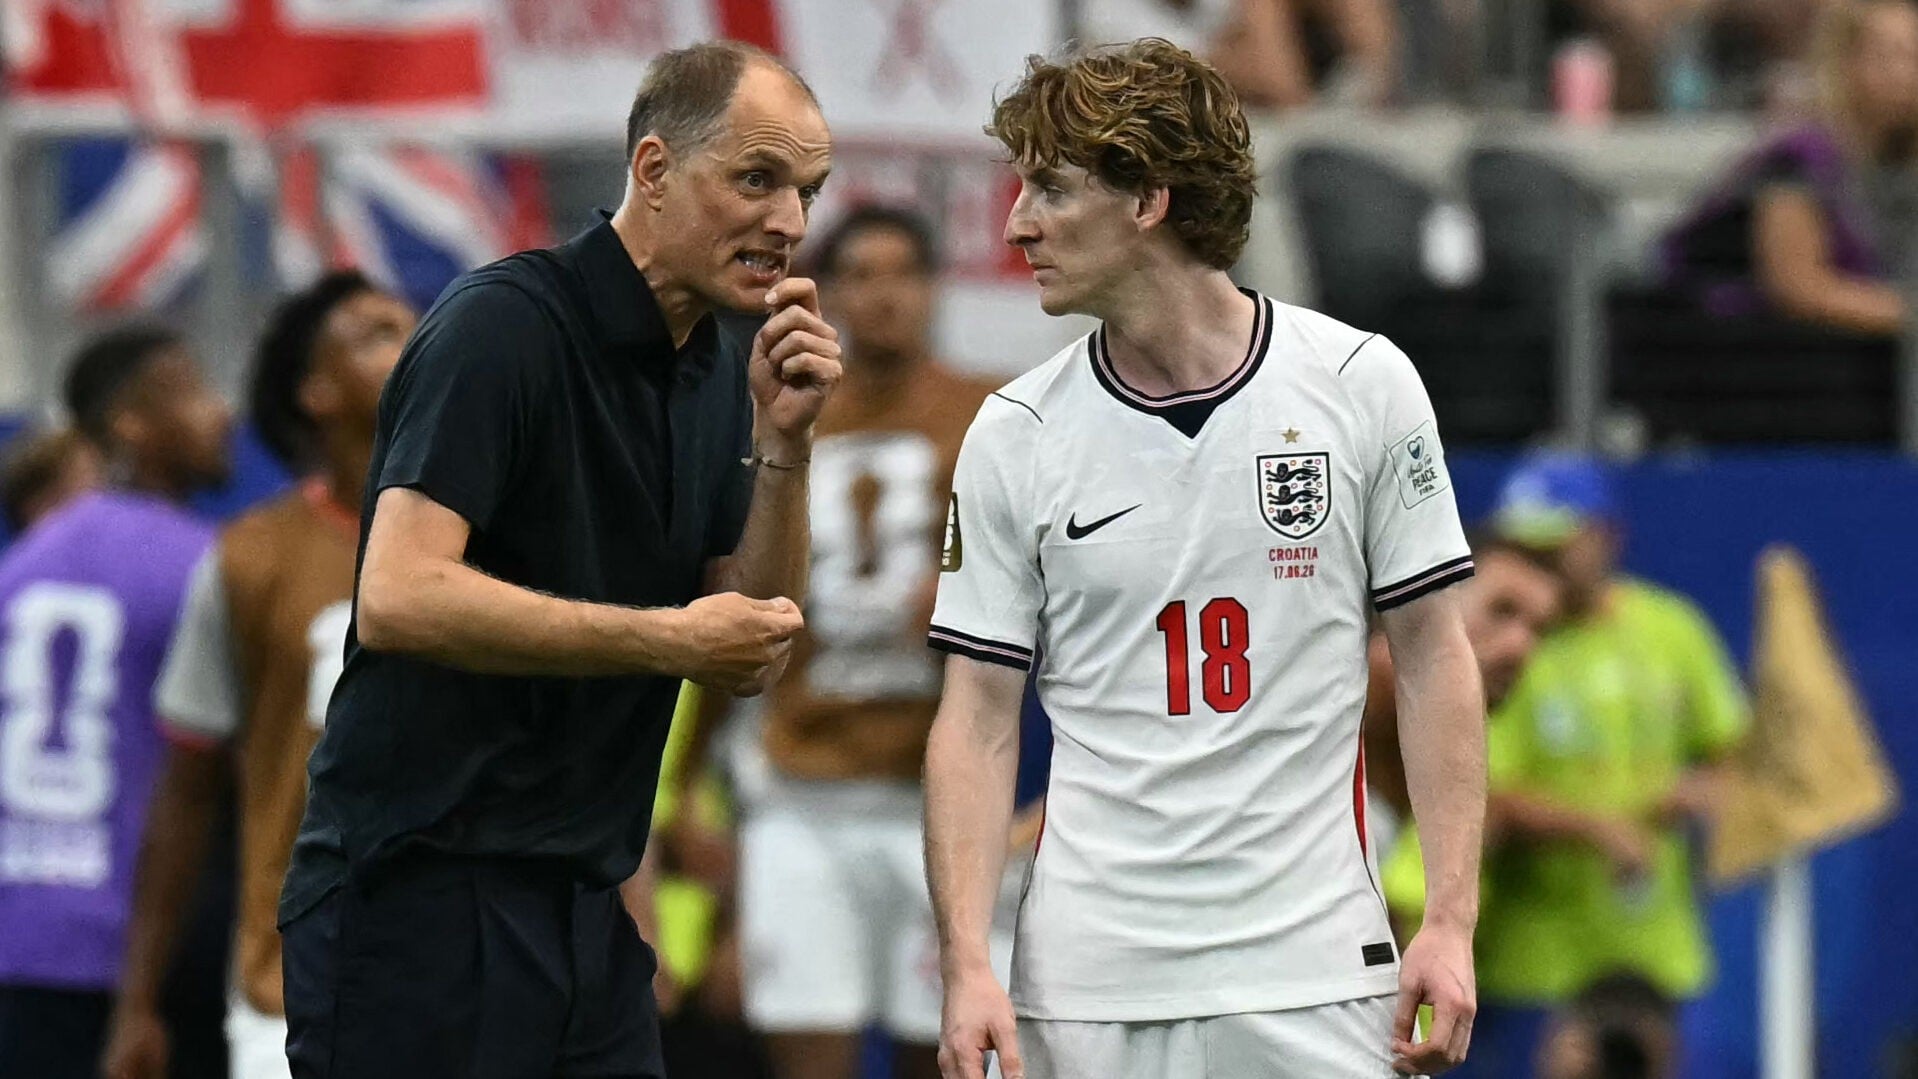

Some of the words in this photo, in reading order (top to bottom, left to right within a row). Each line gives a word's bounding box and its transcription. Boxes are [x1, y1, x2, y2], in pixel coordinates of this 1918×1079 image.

[1412, 467, 1438, 491] PEACE
[1269, 547, 1318, 561] CROATIA
[1274, 564, 1315, 580] 17.06.26
[1156, 597, 1251, 716] 18
